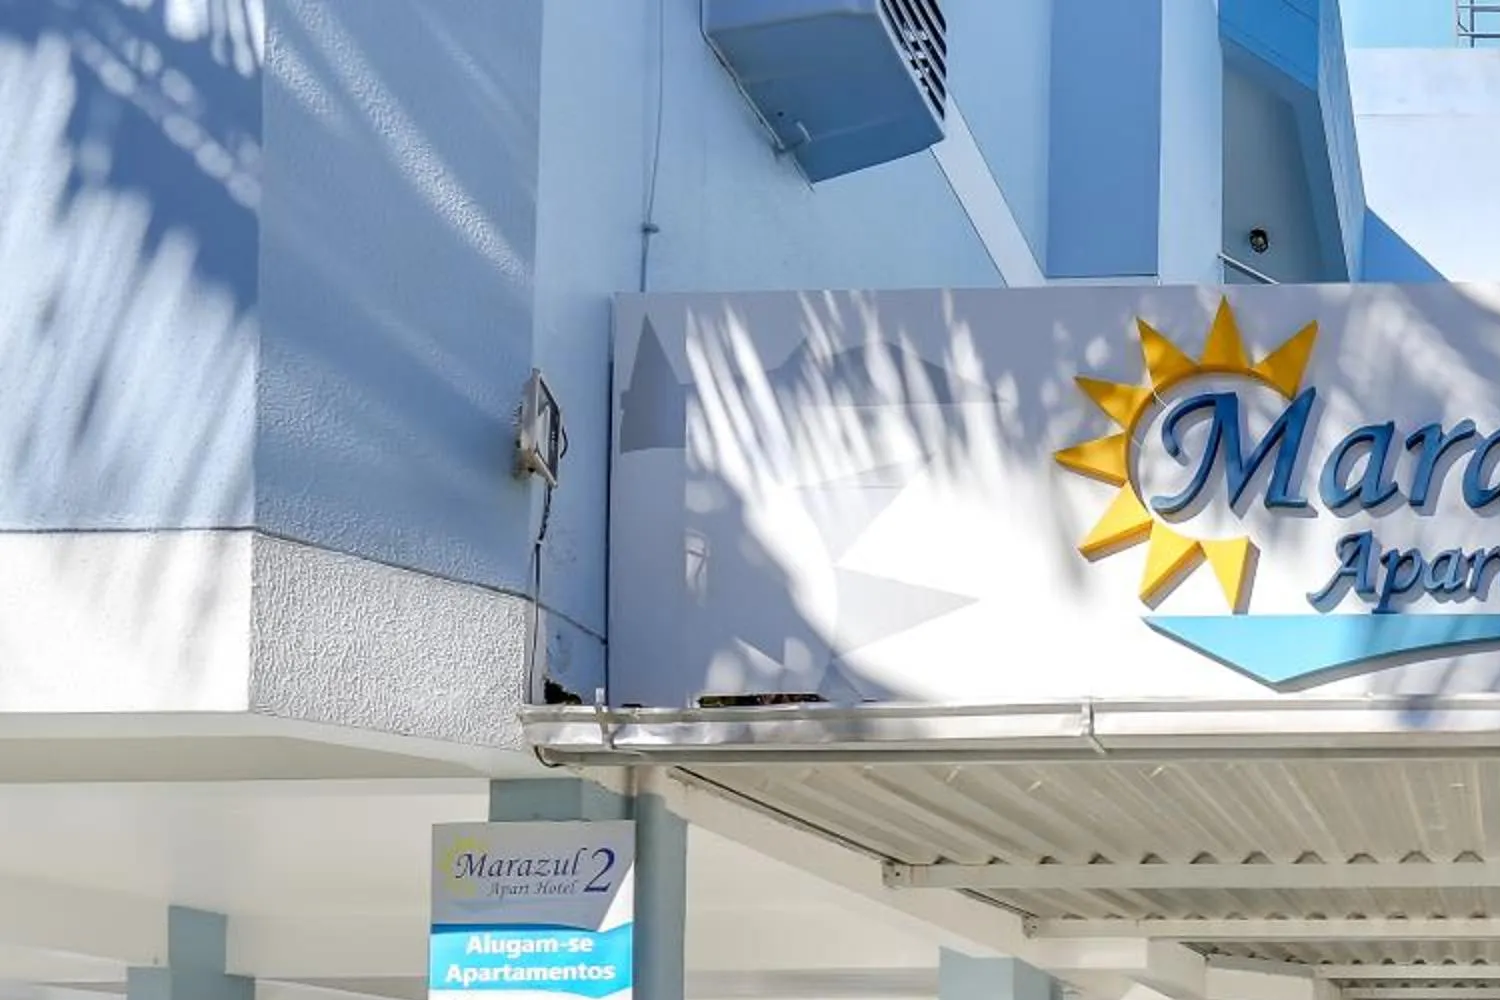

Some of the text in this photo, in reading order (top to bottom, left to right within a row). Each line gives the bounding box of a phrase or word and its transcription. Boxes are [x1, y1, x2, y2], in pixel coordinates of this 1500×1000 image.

[455, 847, 615, 893] Marazul 2
[487, 880, 577, 899] Apart Hotel
[467, 935, 593, 958] Alugam-se
[445, 963, 616, 987] Apartamentos
